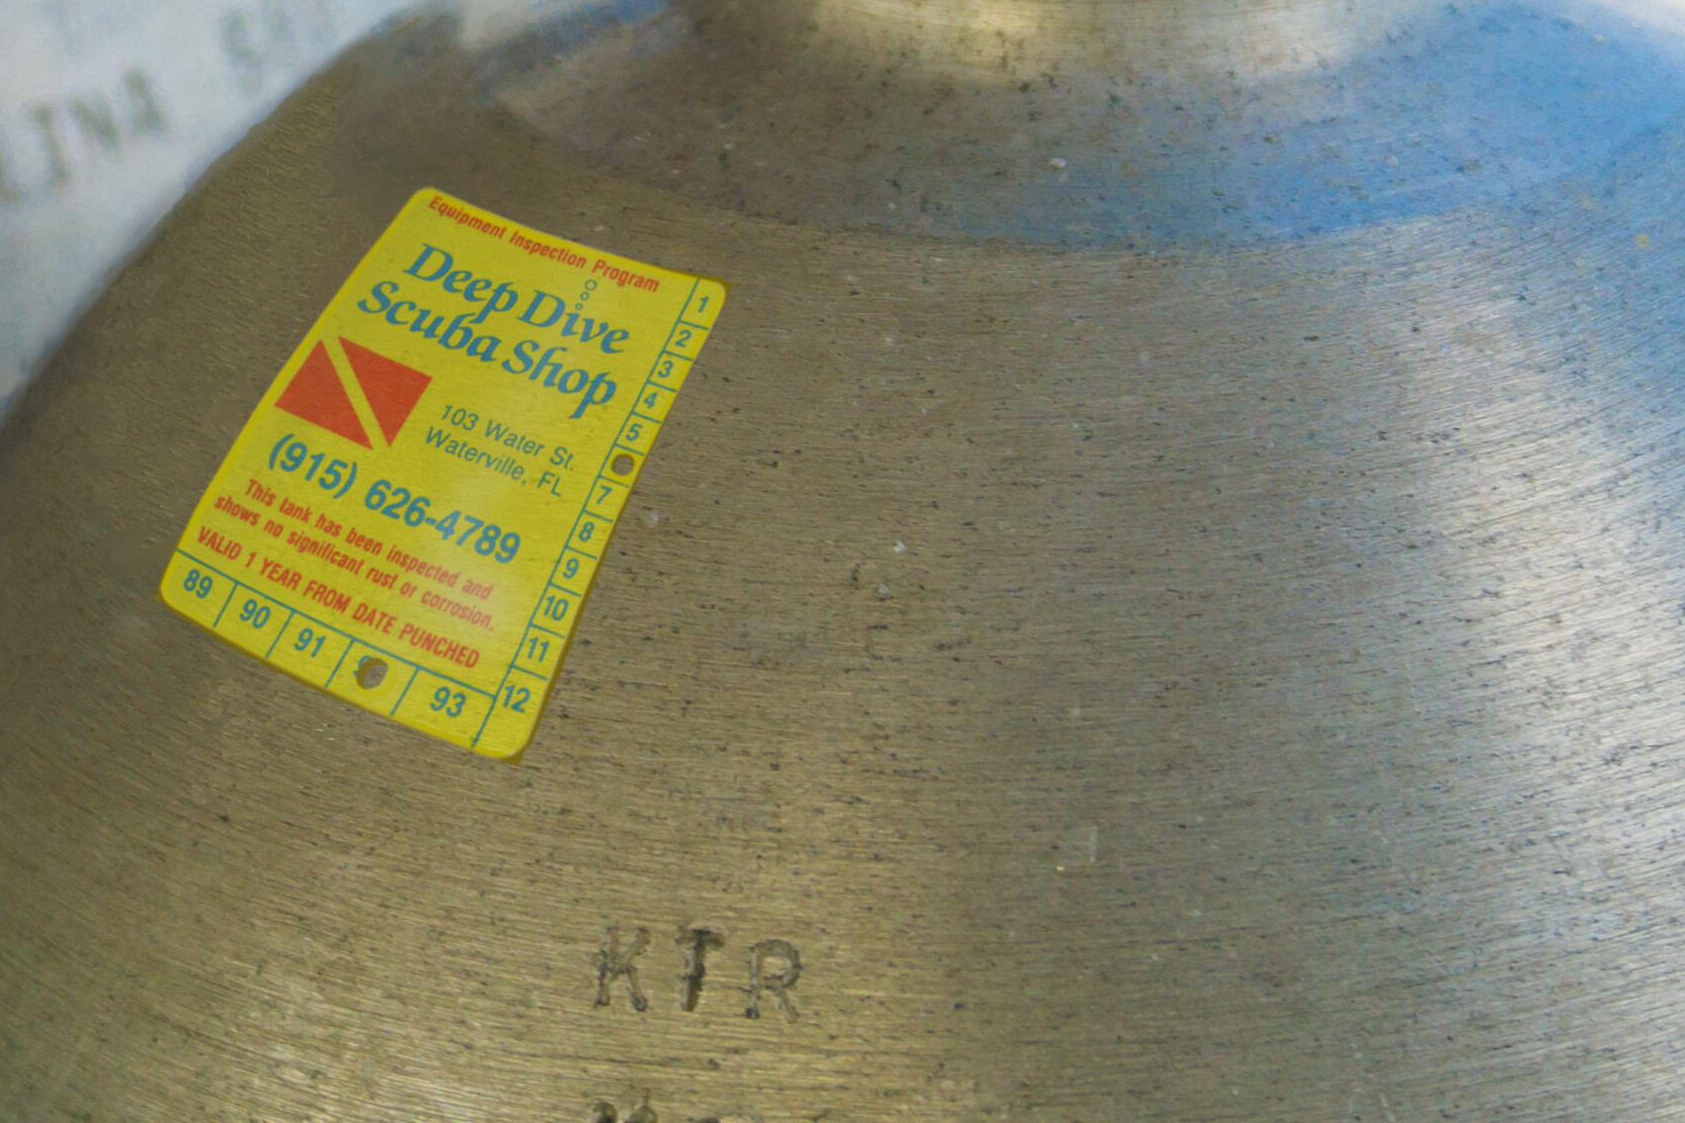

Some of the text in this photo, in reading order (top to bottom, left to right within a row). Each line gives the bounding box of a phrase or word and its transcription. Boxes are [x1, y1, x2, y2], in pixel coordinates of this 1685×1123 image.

[428, 195, 660, 293] Equipment Inspection Program
[402, 243, 630, 354] Deep Dive
[698, 295, 709, 313] 1
[357, 281, 617, 419] Scuba Shop
[674, 329, 692, 348] 2
[658, 360, 674, 378] 3
[643, 392, 658, 409] 4
[442, 404, 574, 471] 103 Water St.
[625, 423, 643, 442] 5
[425, 426, 561, 497] Waterville, FL
[268, 433, 521, 563] (915) 626-4789
[596, 485, 612, 505] 7
[245, 478, 494, 600] This tank has been inspected and
[578, 521, 595, 542] 8
[214, 495, 494, 631] shows no significant rust or corrosion.
[563, 557, 579, 579] 9
[184, 569, 213, 598] 89
[197, 525, 480, 668] VALID 1 YEAR FROM DATE PUNCHED
[239, 598, 271, 629] 90
[543, 594, 569, 621] 10
[293, 627, 327, 658] 91
[527, 637, 550, 663] 11
[429, 686, 467, 718] 93
[503, 684, 531, 713] 12
[592, 924, 803, 1024] KTR
